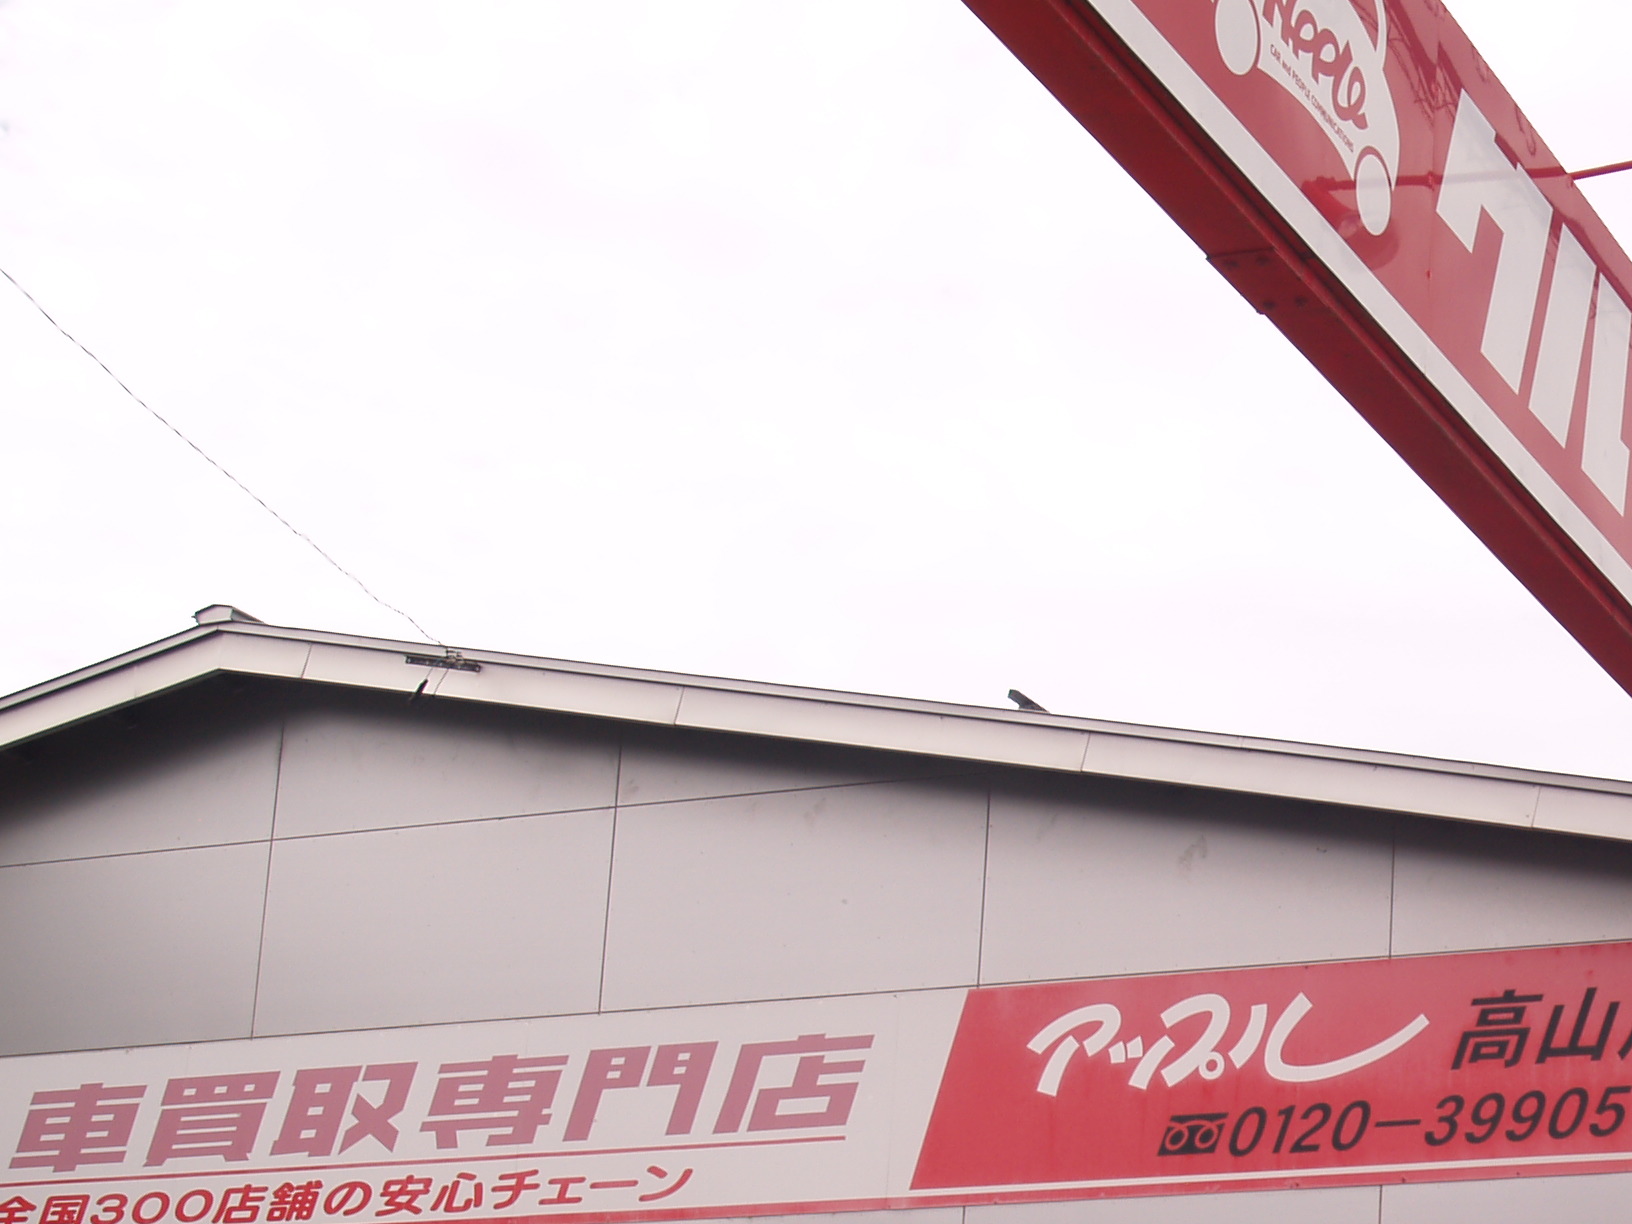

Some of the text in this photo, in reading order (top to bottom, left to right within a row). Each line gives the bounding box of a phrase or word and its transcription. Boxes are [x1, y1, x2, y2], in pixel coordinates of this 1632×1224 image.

[8, 1033, 875, 1172] 車買取専門店
[1026, 992, 1430, 1096] アップル
